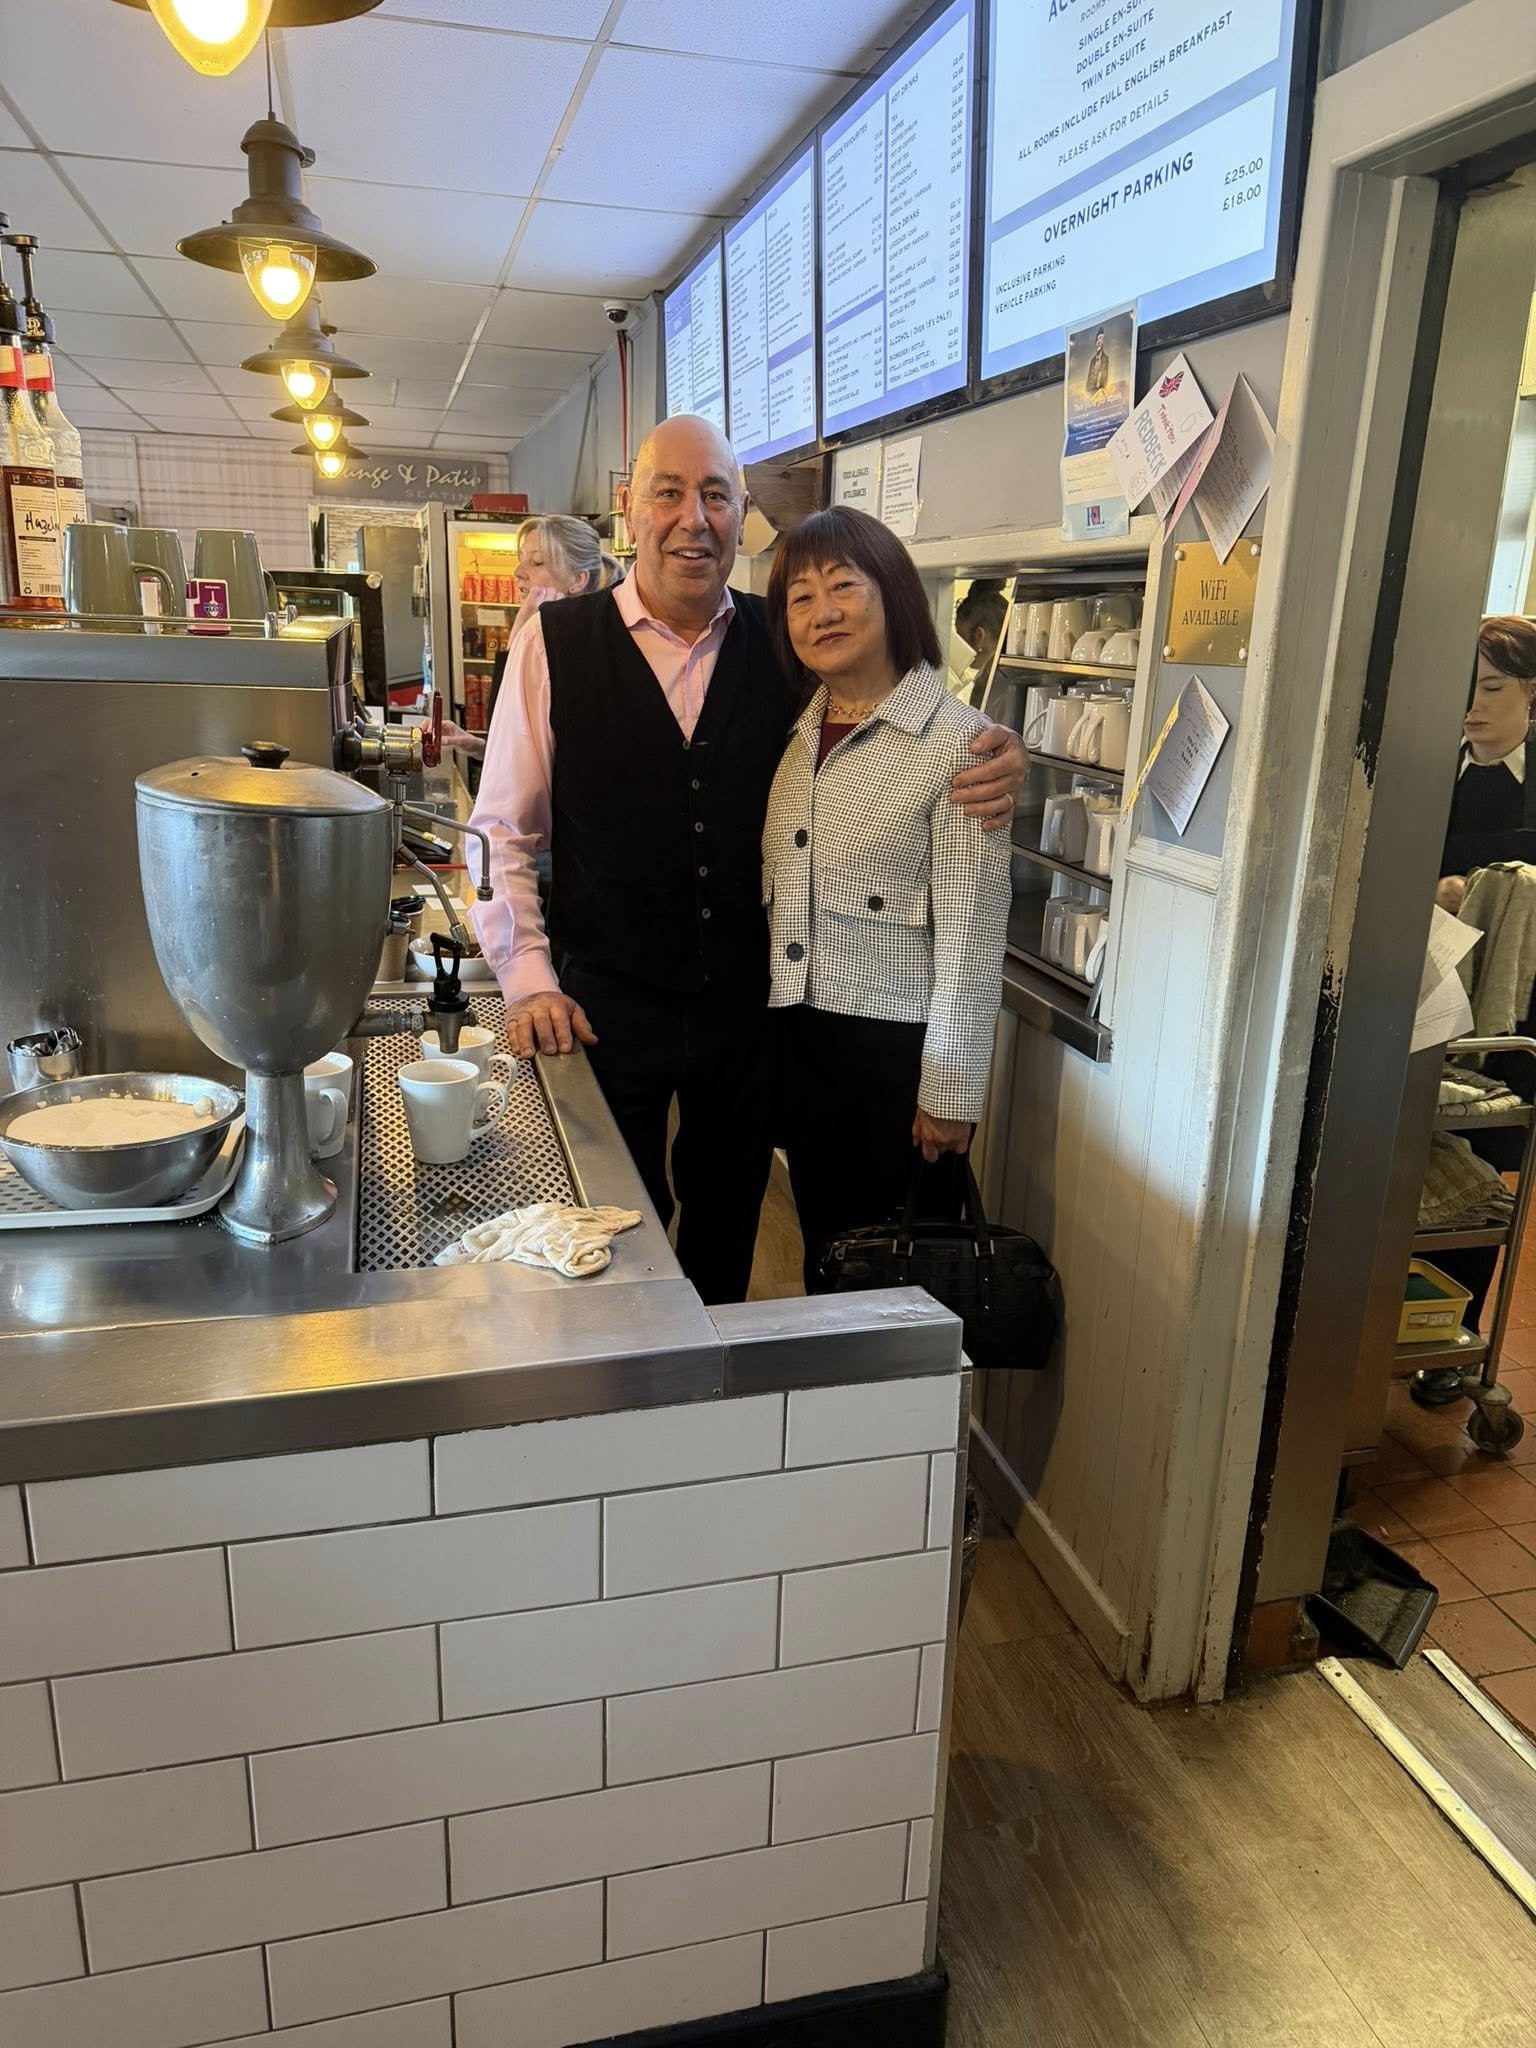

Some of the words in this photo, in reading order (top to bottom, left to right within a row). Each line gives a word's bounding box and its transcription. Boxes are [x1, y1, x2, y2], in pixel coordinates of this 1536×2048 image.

[1076, 41, 1111, 74] DOUBLE
[1112, 8, 1155, 48] EN-SUITE
[1078, 18, 1110, 50] SINGLE
[1018, 145, 1032, 162] ALL
[1034, 126, 1060, 151] ROOMS
[1061, 101, 1098, 134] INCLUDE
[1100, 86, 1122, 109] FULL
[1124, 55, 1166, 92] ENGLISH
[1168, 10, 1233, 63] BREAKFAST
[1081, 69, 1104, 93] TWIN
[1105, 38, 1147, 76] EN-SUITE
[1058, 139, 1090, 167] PLEASE
[1091, 127, 1108, 148] ASK
[1110, 115, 1128, 136] FOR
[1129, 89, 1170, 123] DETAILS
[1224, 156, 1264, 187] £25.00
[1043, 191, 1119, 244] OVERNIGHT
[1123, 151, 1195, 204] PARKING
[1222, 183, 1262, 213] £18.00
[995, 269, 1032, 297] INCLUSIVE
[1032, 254, 1067, 280] PARKING
[995, 294, 1024, 316] VEHICLE
[1024, 279, 1058, 304] PARKING
[1134, 408, 1167, 478] REDBECK
[1200, 579, 1228, 601] WiFi
[1181, 609, 1240, 626] AVAILABLE
